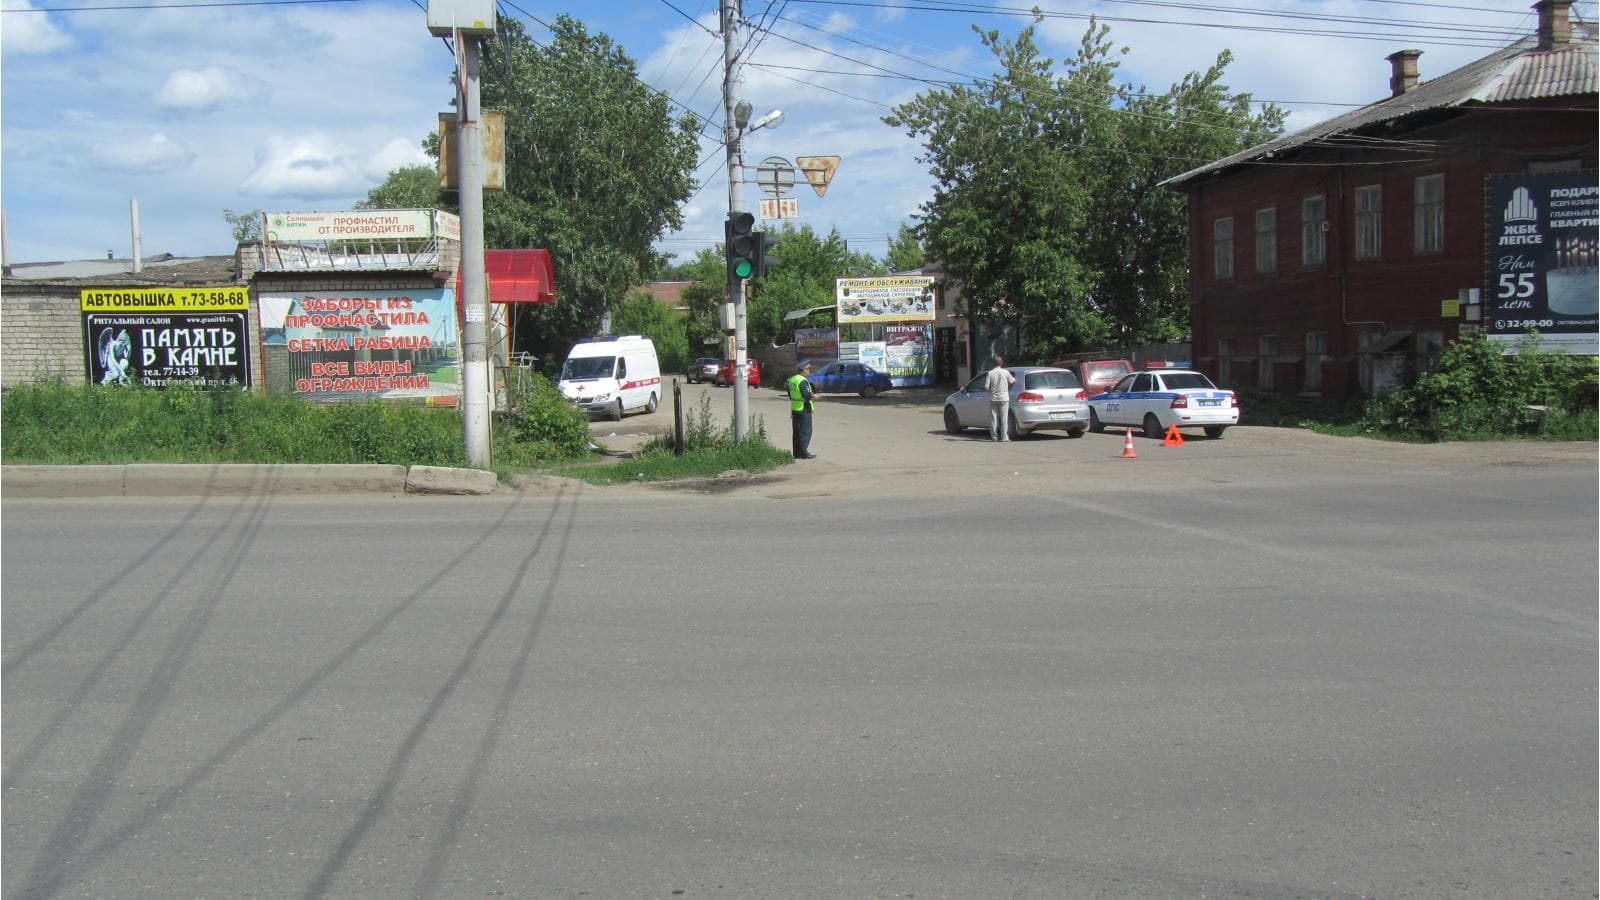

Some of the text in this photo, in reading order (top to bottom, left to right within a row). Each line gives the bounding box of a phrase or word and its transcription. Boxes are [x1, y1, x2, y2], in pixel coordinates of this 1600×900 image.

[333, 216, 399, 226] ПРОФНАСТИЛ
[1550, 218, 1599, 228] КВАРТИ
[318, 224, 415, 235] ОТ ПРОИЗВОДИТЕЛЯ
[1504, 224, 1537, 235] ЖБК
[1498, 234, 1543, 246] ЛЕПСЕ
[876, 278, 932, 287] ОБСЛУЖИВАНИЕ
[1497, 272, 1535, 298] 55
[86, 293, 176, 306] АВТОВЫШКА
[302, 296, 412, 312] ЗАБОРЫ ИЗ
[1498, 299, 1533, 309] лет
[94, 317, 171, 325] РИТУАЛЬНЫЙ САЛОН
[285, 311, 431, 328] ПРОФНАСТИЛА
[1507, 319, 1553, 328] 32-99-00
[886, 325, 923, 333] ВИТРАЖИ
[142, 328, 236, 347] ПАМЯТЬ
[287, 335, 431, 352] СЕТКА РАБИЦА
[142, 347, 238, 366] В КАМНЕ
[163, 367, 199, 376] 77-14-39
[311, 360, 412, 377] ВСЕ ВИДЫ
[296, 372, 430, 392] ОГРАЖДЕНИЙ
[1106, 403, 1120, 414] ДПС
